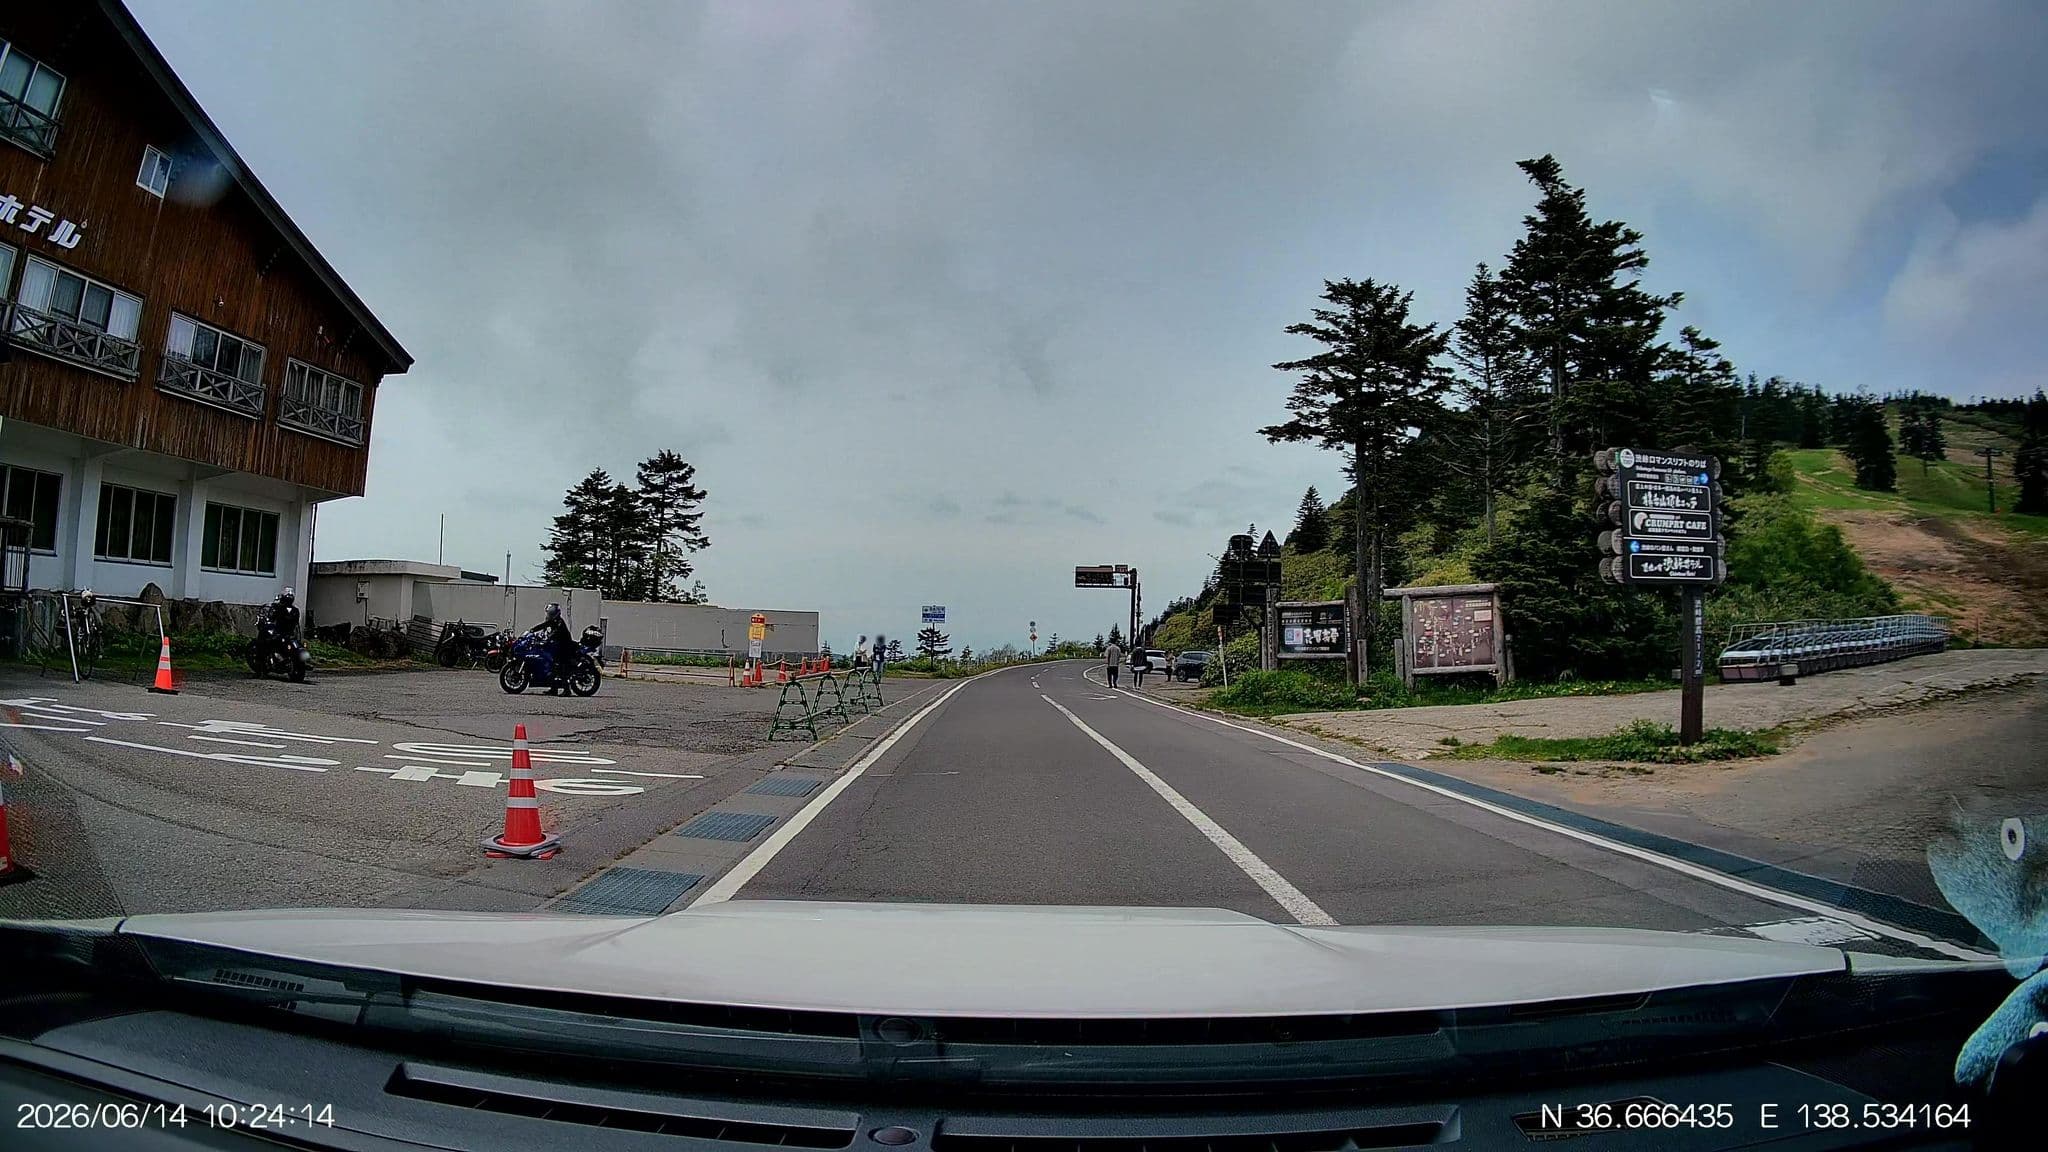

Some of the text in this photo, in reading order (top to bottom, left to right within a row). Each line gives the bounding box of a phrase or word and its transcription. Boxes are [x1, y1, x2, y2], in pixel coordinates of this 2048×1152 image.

[0, 194, 82, 249] ホテル
[1685, 521, 1707, 530] CAFE
